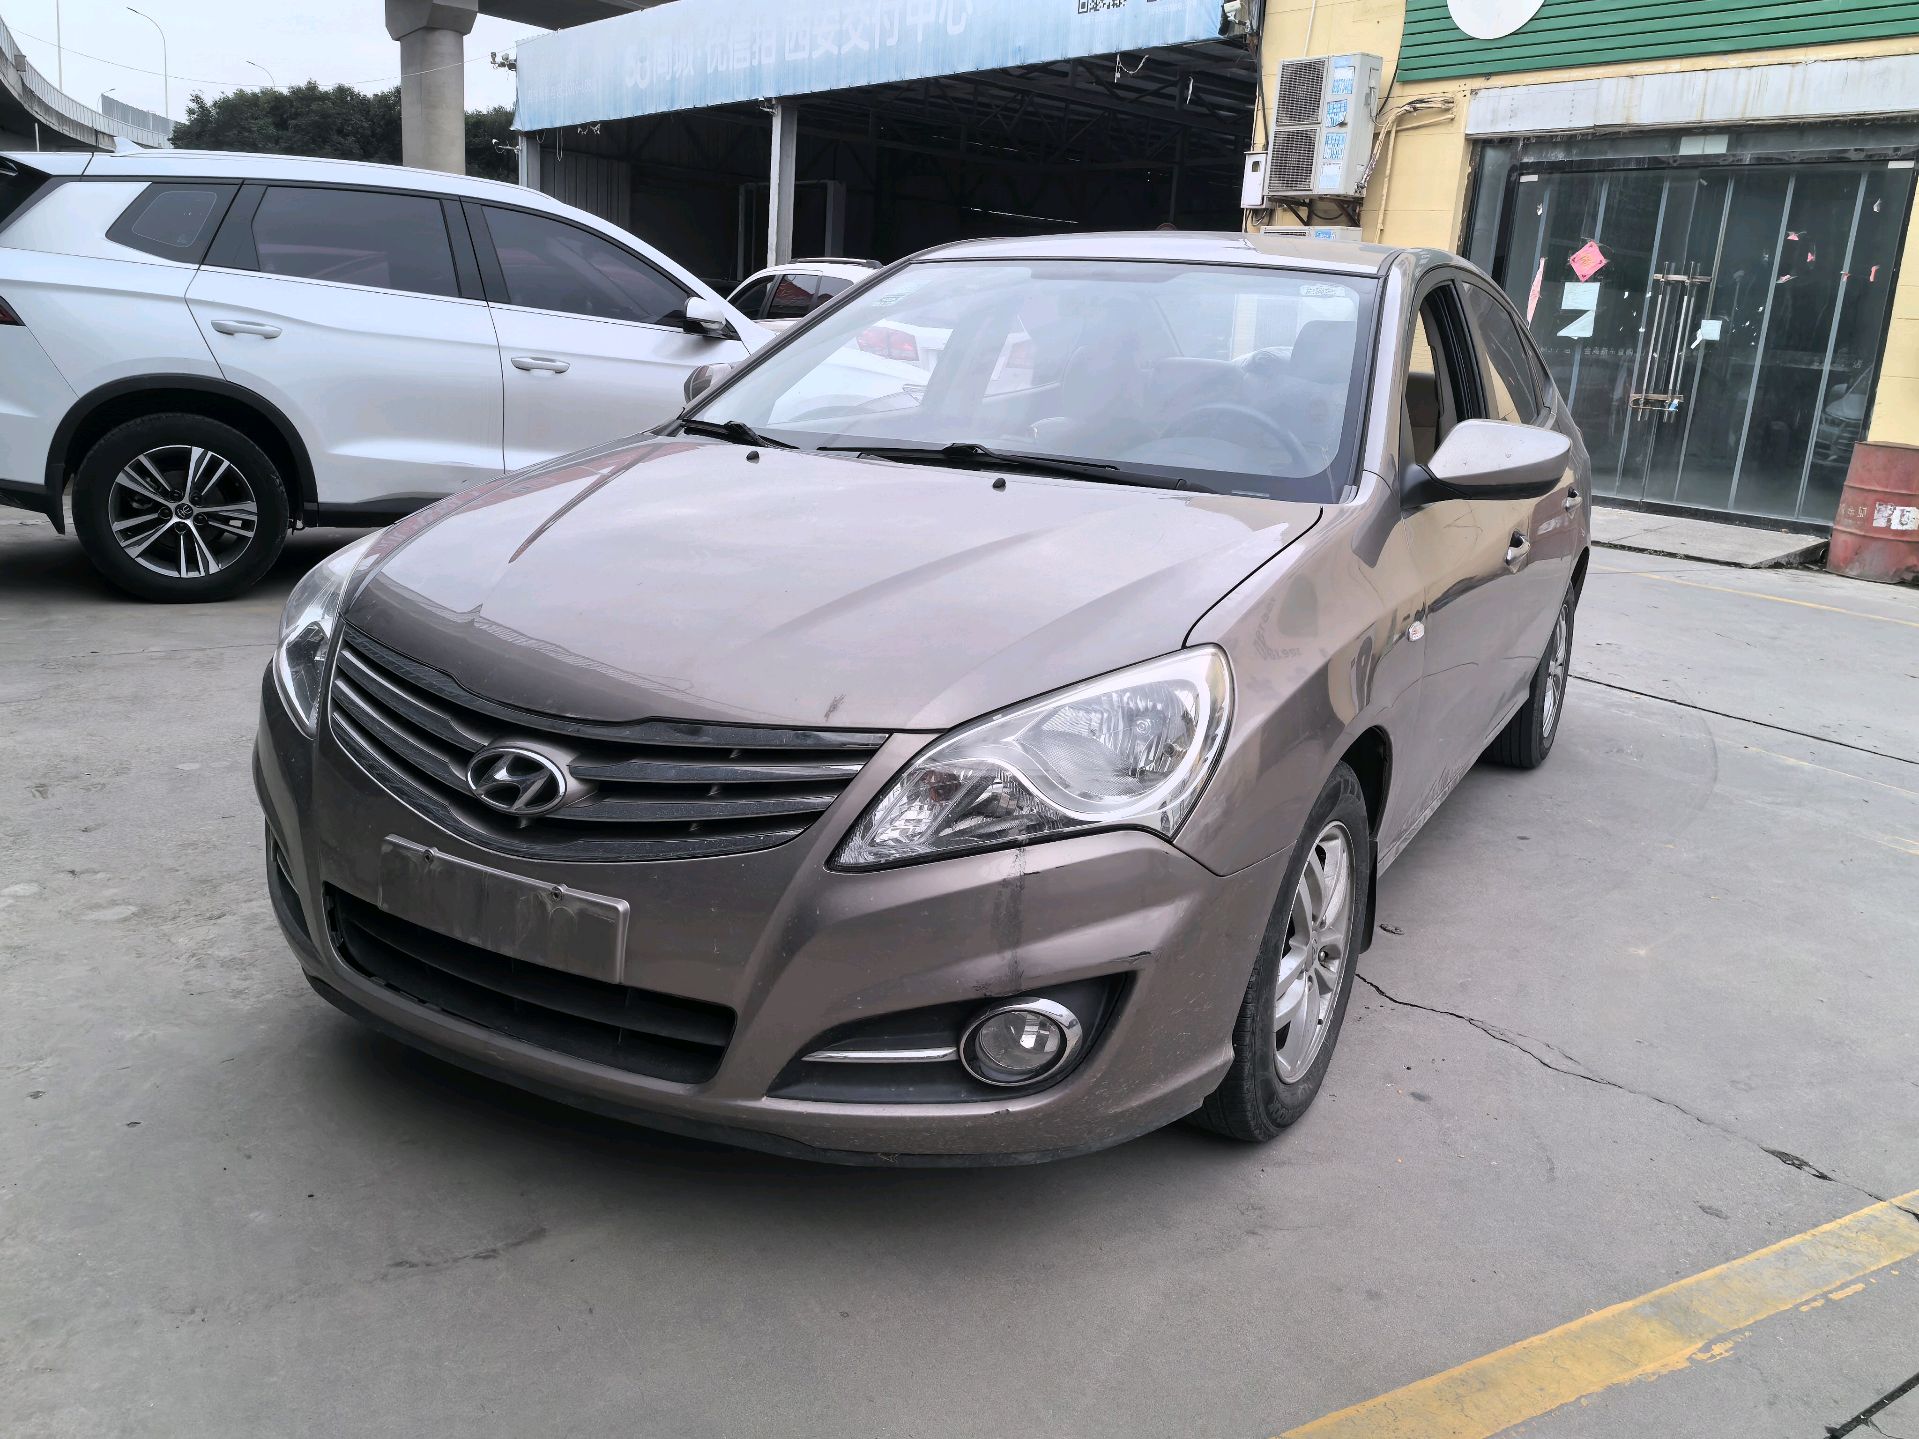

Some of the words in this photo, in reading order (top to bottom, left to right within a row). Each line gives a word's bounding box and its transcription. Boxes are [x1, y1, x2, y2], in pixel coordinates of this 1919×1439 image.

[784, 0, 972, 61] 西安交付中心
